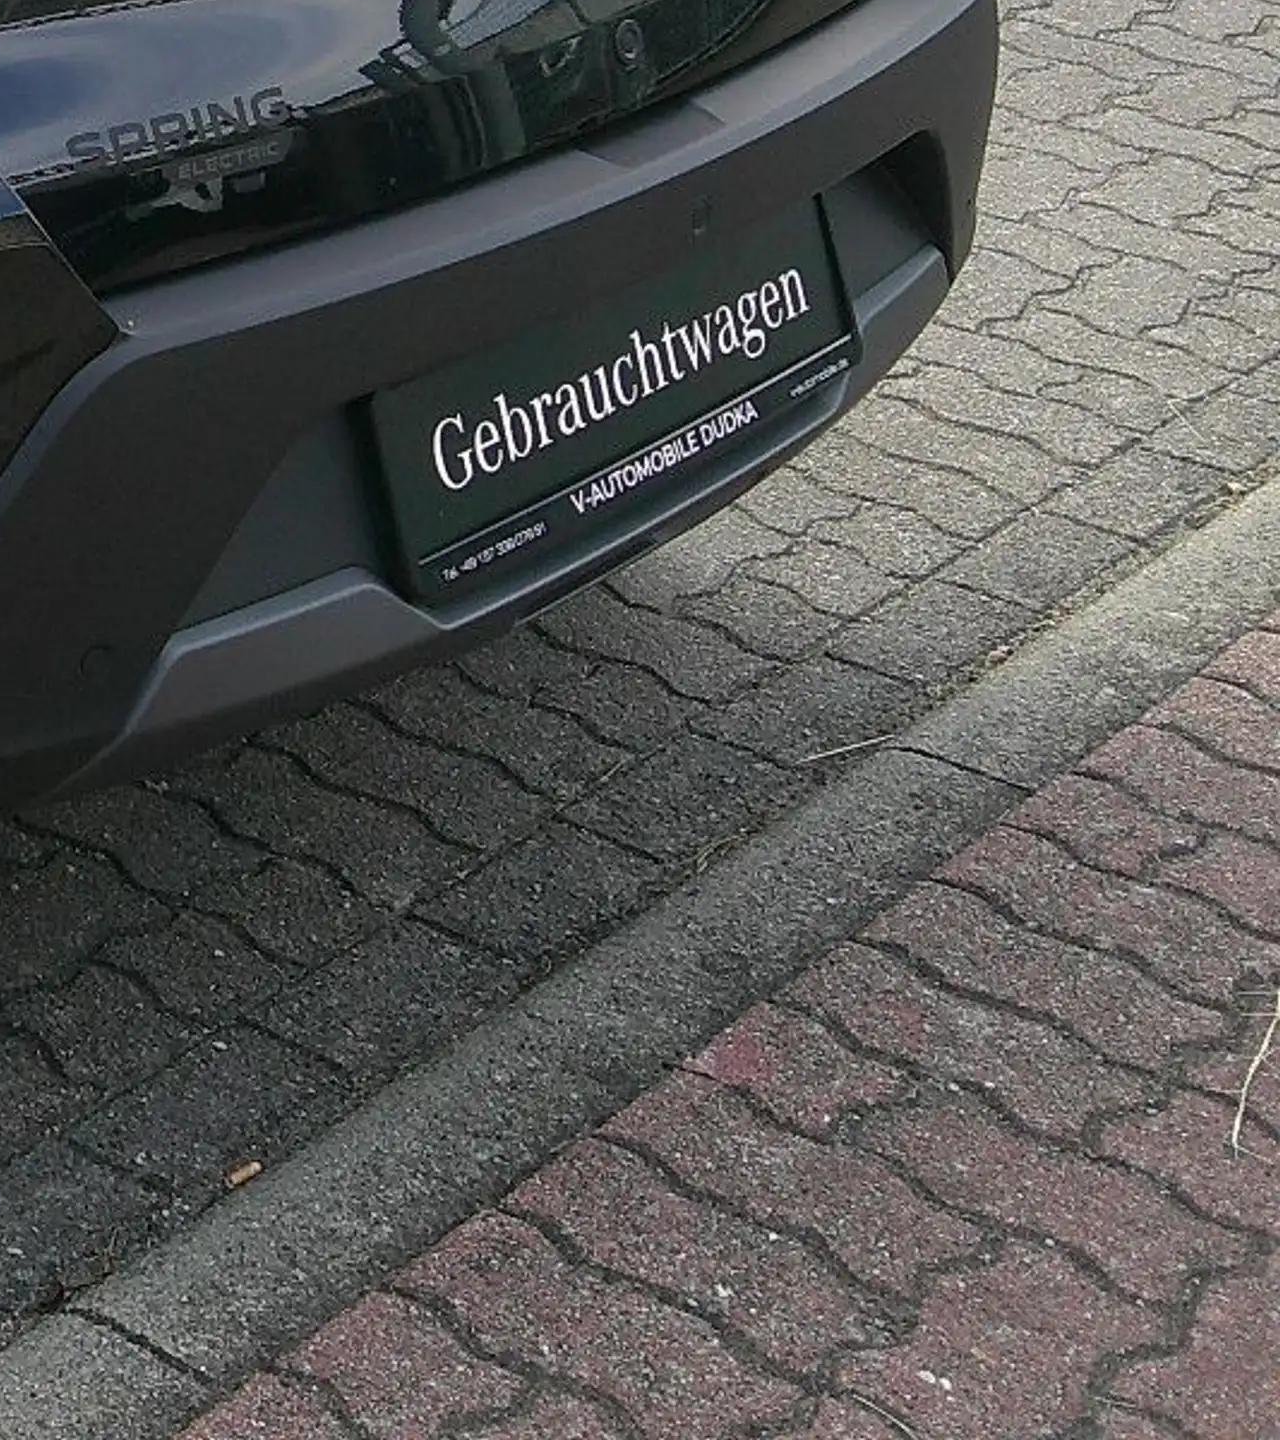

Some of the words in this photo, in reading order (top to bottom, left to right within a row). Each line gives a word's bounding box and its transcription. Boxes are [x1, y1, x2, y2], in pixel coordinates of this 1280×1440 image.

[66, 86, 293, 164] SPRING
[178, 141, 281, 180] ELECTRIC
[433, 267, 811, 490] Gebrauchtwagen
[569, 430, 701, 514] V-AUTOMOBILE
[699, 400, 760, 447] DUDKA
